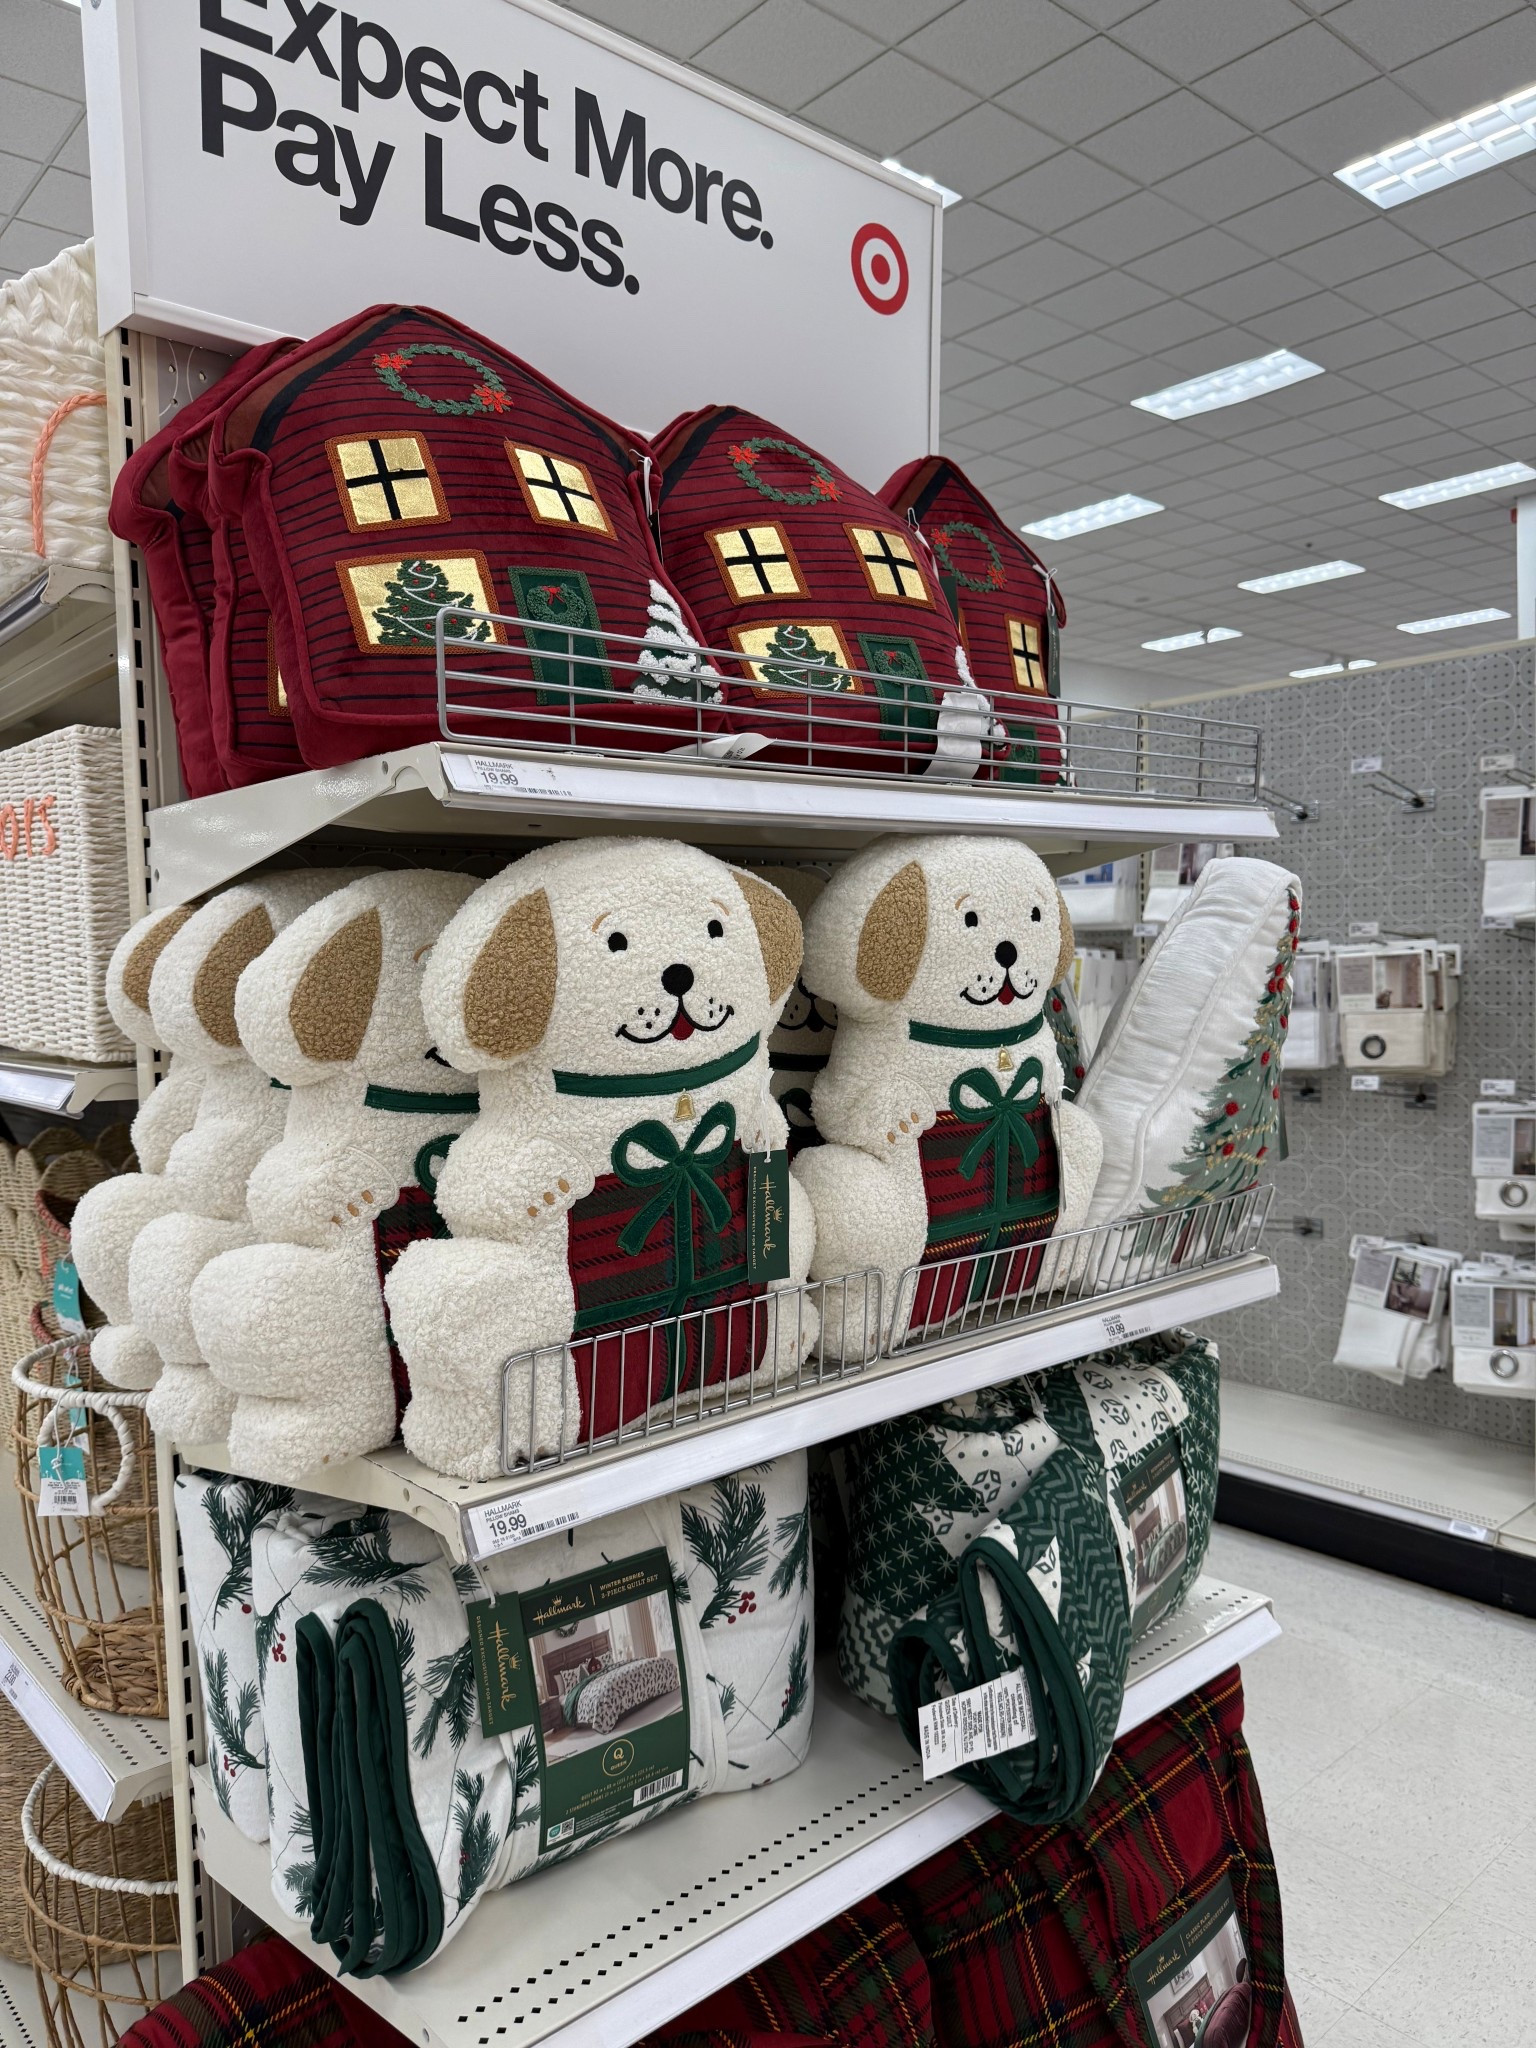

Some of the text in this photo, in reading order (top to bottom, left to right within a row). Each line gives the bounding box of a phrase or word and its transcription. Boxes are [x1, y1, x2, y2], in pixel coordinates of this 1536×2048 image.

[200, 0, 774, 249] xpect More.
[200, 47, 640, 295] Pay Less.
[475, 760, 513, 770] HALLMARK
[481, 771, 518, 786] 19.99
[759, 1174, 776, 1260] Hallmark
[1106, 1323, 1125, 1336] 19.99
[484, 1500, 522, 1518] HALLMARK
[486, 1508, 520, 1523] PILLOW SHAMS
[489, 1514, 527, 1537] 19.99
[600, 1571, 644, 1591] WINTER BERRIES
[626, 1580, 645, 1591] QUILT
[647, 1574, 659, 1585] SET
[533, 1596, 586, 1626] Hallmark
[476, 1616, 484, 1646] DESIGNED
[481, 1647, 489, 1686] EXCLUSIVELY
[488, 1620, 517, 1711] Hallmark
[613, 1747, 624, 1760] Q
[610, 1761, 627, 1771] QUEEN
[1146, 1949, 1181, 1985] Hallmark
